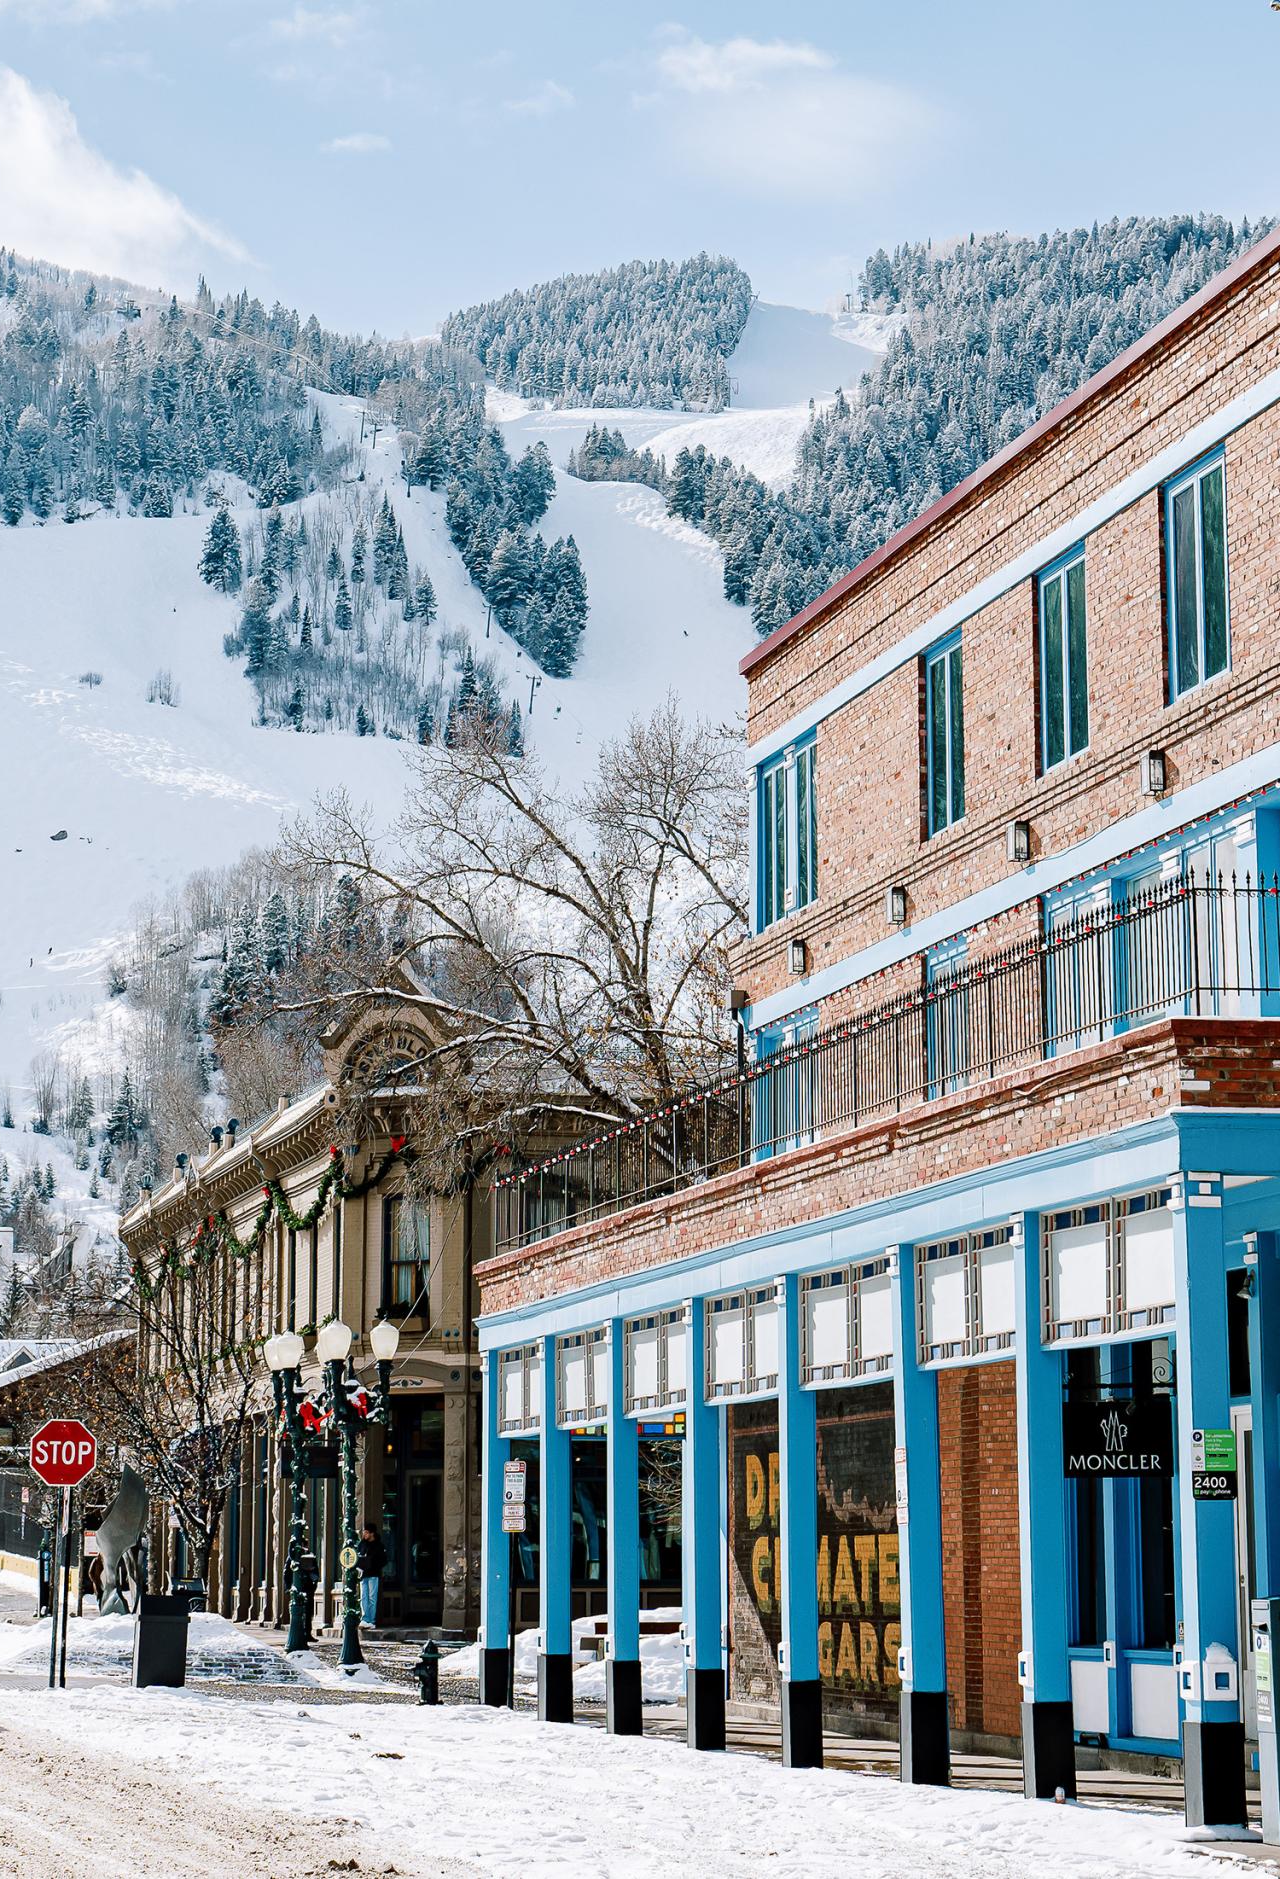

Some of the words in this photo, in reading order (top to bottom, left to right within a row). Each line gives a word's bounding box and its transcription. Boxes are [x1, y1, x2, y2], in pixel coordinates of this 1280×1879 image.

[35, 1440, 92, 1465] STOP
[1069, 1454, 1162, 1470] MONCLER
[1194, 1477, 1227, 1488] 2400
